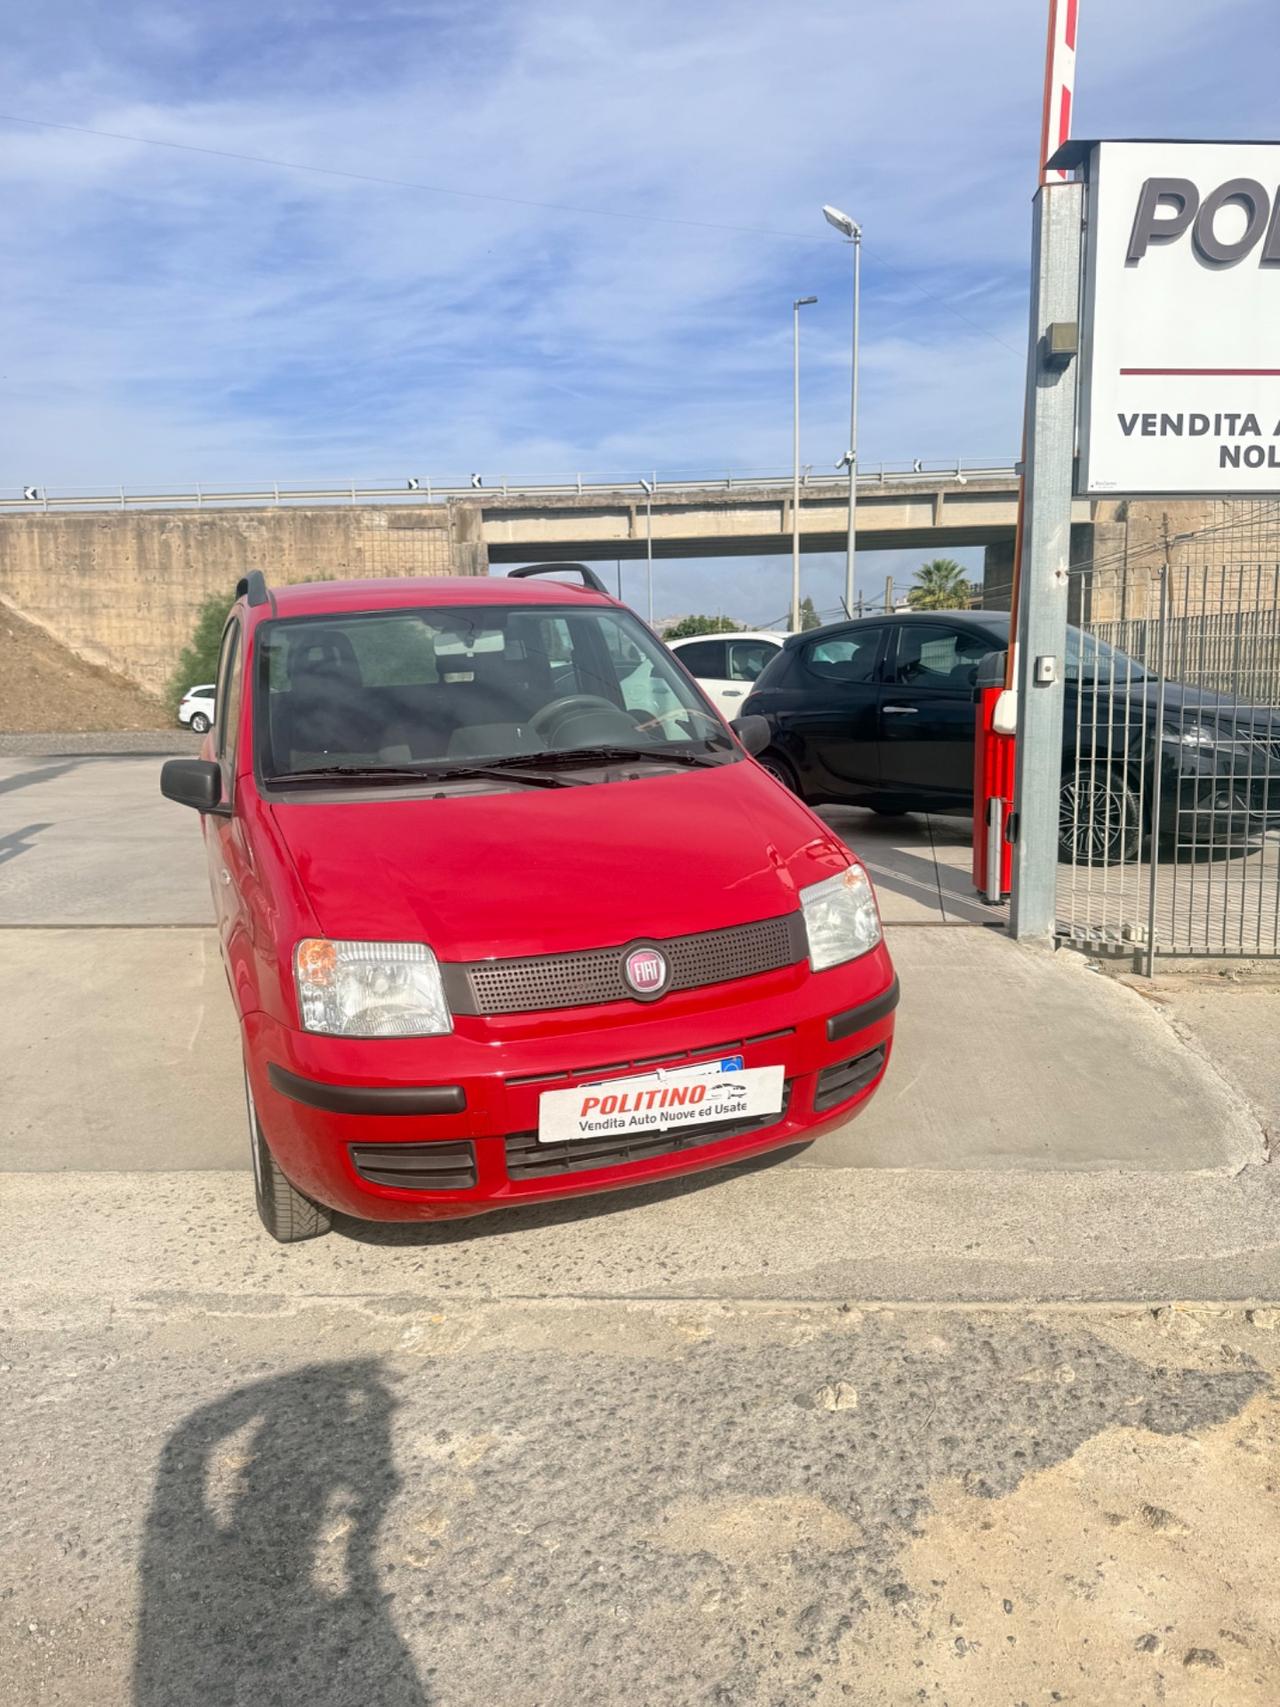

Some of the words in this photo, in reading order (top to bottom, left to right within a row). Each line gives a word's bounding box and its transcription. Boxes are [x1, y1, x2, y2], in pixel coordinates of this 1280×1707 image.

[1117, 413, 1262, 436] VENDITA
[1219, 444, 1280, 468] NOL
[634, 959, 658, 983] FIAT
[580, 1084, 706, 1117] POLITINO
[579, 1118, 626, 1131] Vendita
[628, 1114, 657, 1126] Auto
[660, 1110, 695, 1122] Nuove
[698, 1106, 712, 1117] ed
[715, 1101, 748, 1114] Usate
